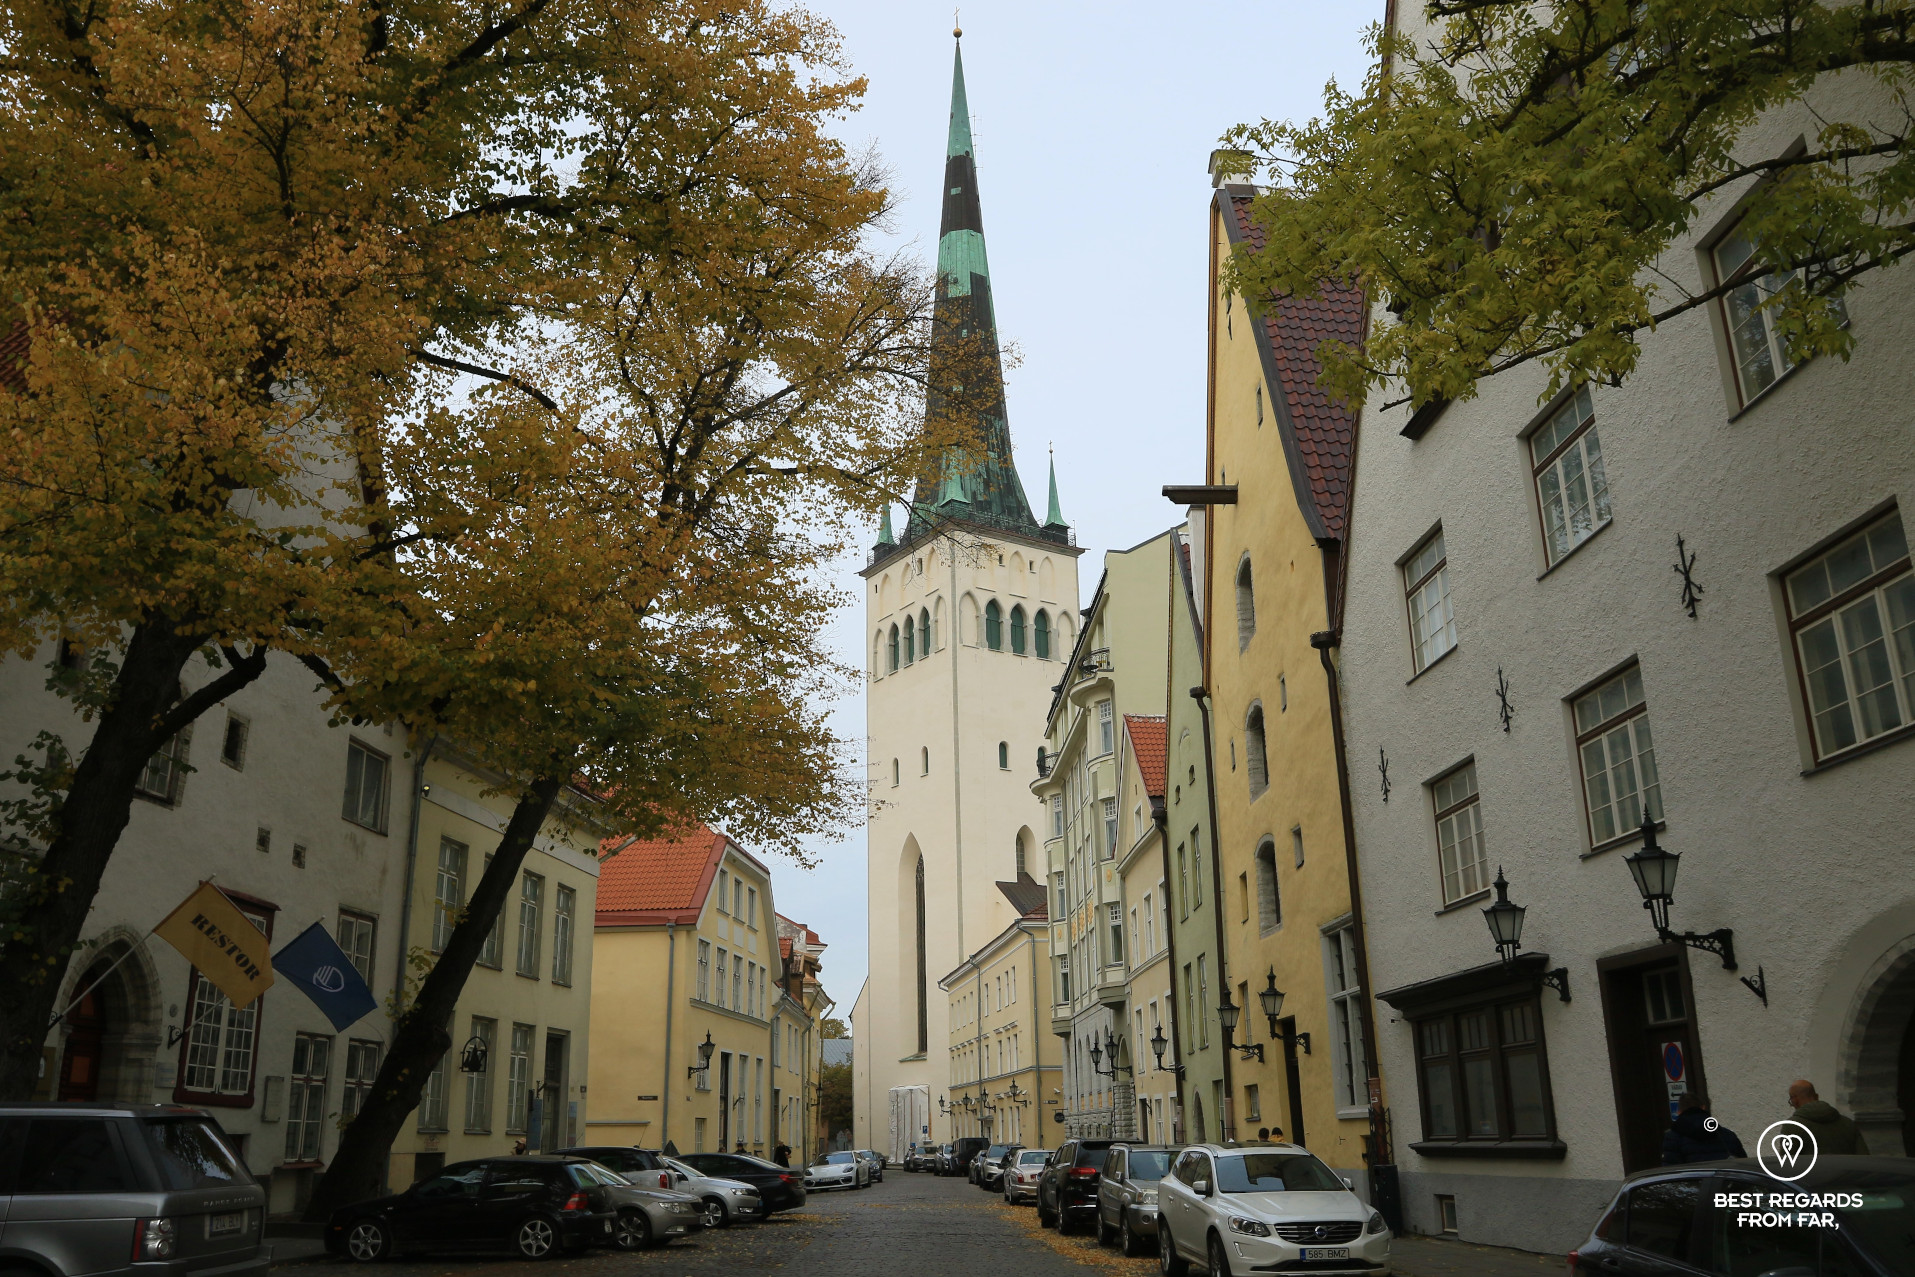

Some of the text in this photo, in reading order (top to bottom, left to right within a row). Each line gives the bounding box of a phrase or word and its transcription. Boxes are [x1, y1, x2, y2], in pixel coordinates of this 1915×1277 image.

[189, 912, 260, 982] RESTOR
[1308, 1249, 1347, 1258] 585 BMZ
